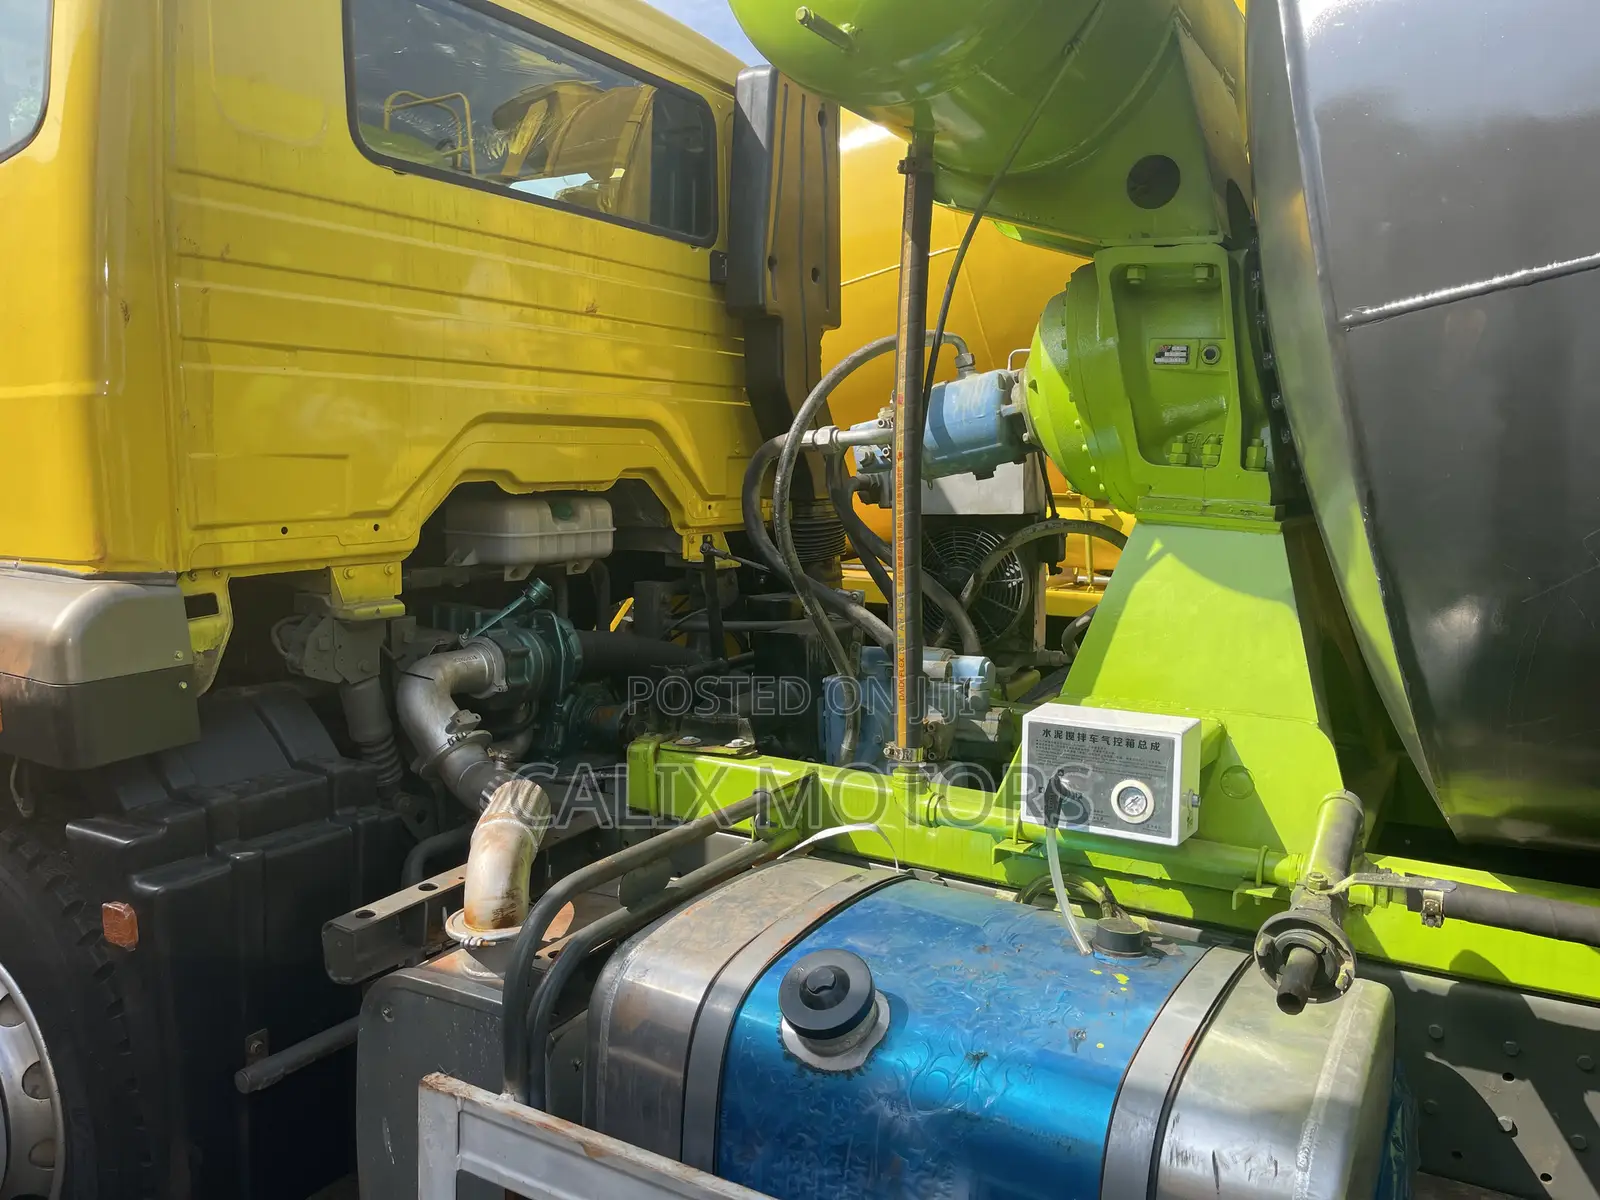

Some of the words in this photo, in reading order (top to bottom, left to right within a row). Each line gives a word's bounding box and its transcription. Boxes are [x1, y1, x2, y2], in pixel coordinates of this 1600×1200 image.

[1041, 728, 1161, 752] 水泥搅拌车气控箱总成
